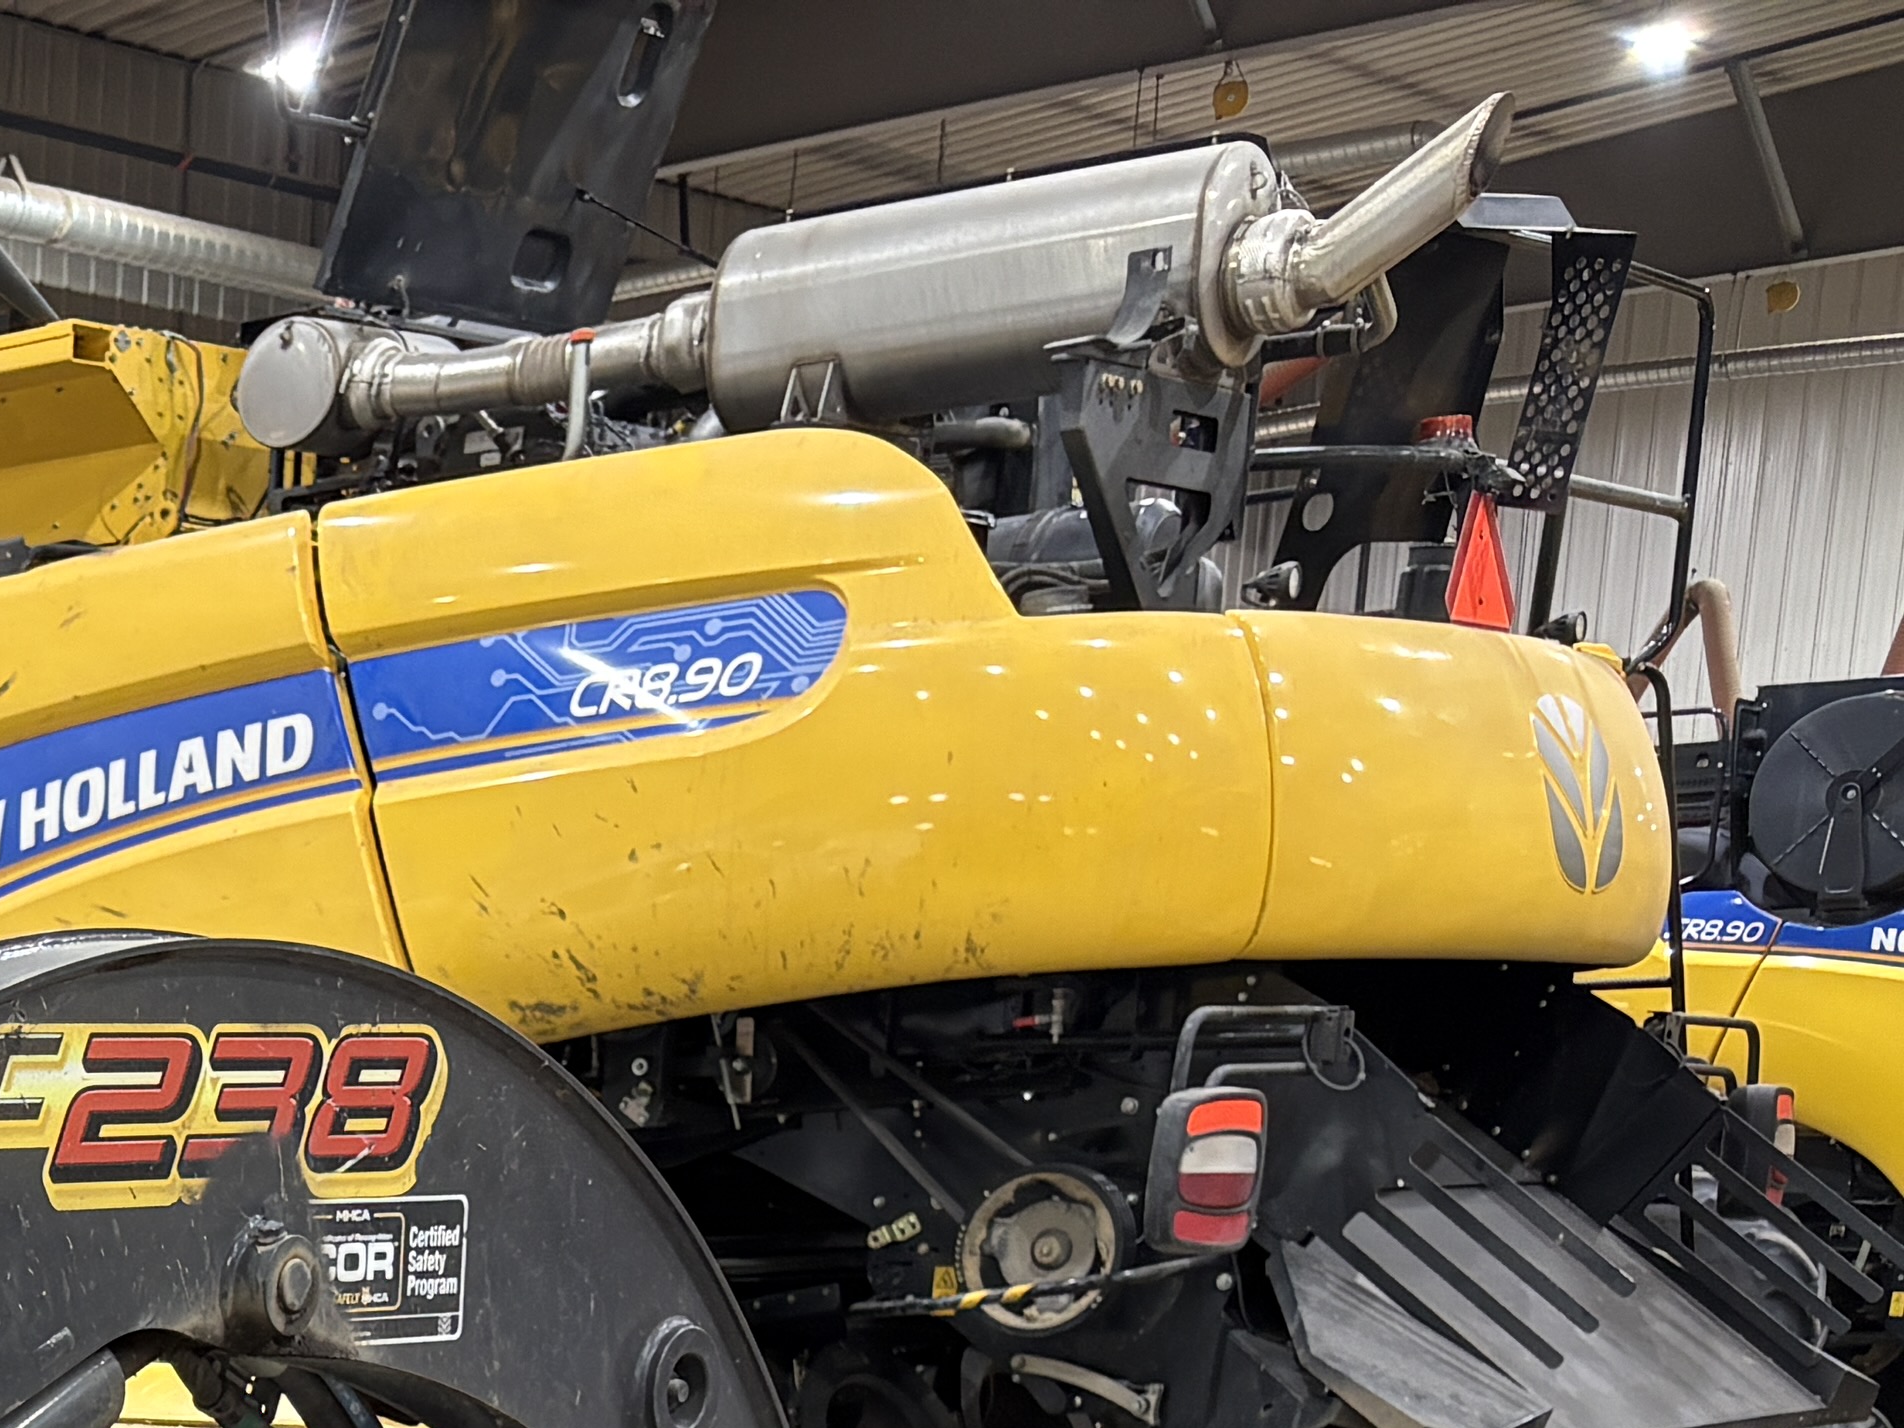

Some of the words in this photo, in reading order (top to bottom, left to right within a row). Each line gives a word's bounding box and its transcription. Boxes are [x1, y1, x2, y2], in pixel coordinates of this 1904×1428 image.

[569, 652, 763, 717] CR8.90
[19, 713, 314, 852] HOLLAND
[409, 1225, 460, 1249] Certified
[407, 1250, 446, 1275] Safety
[406, 1275, 458, 1300] Program
